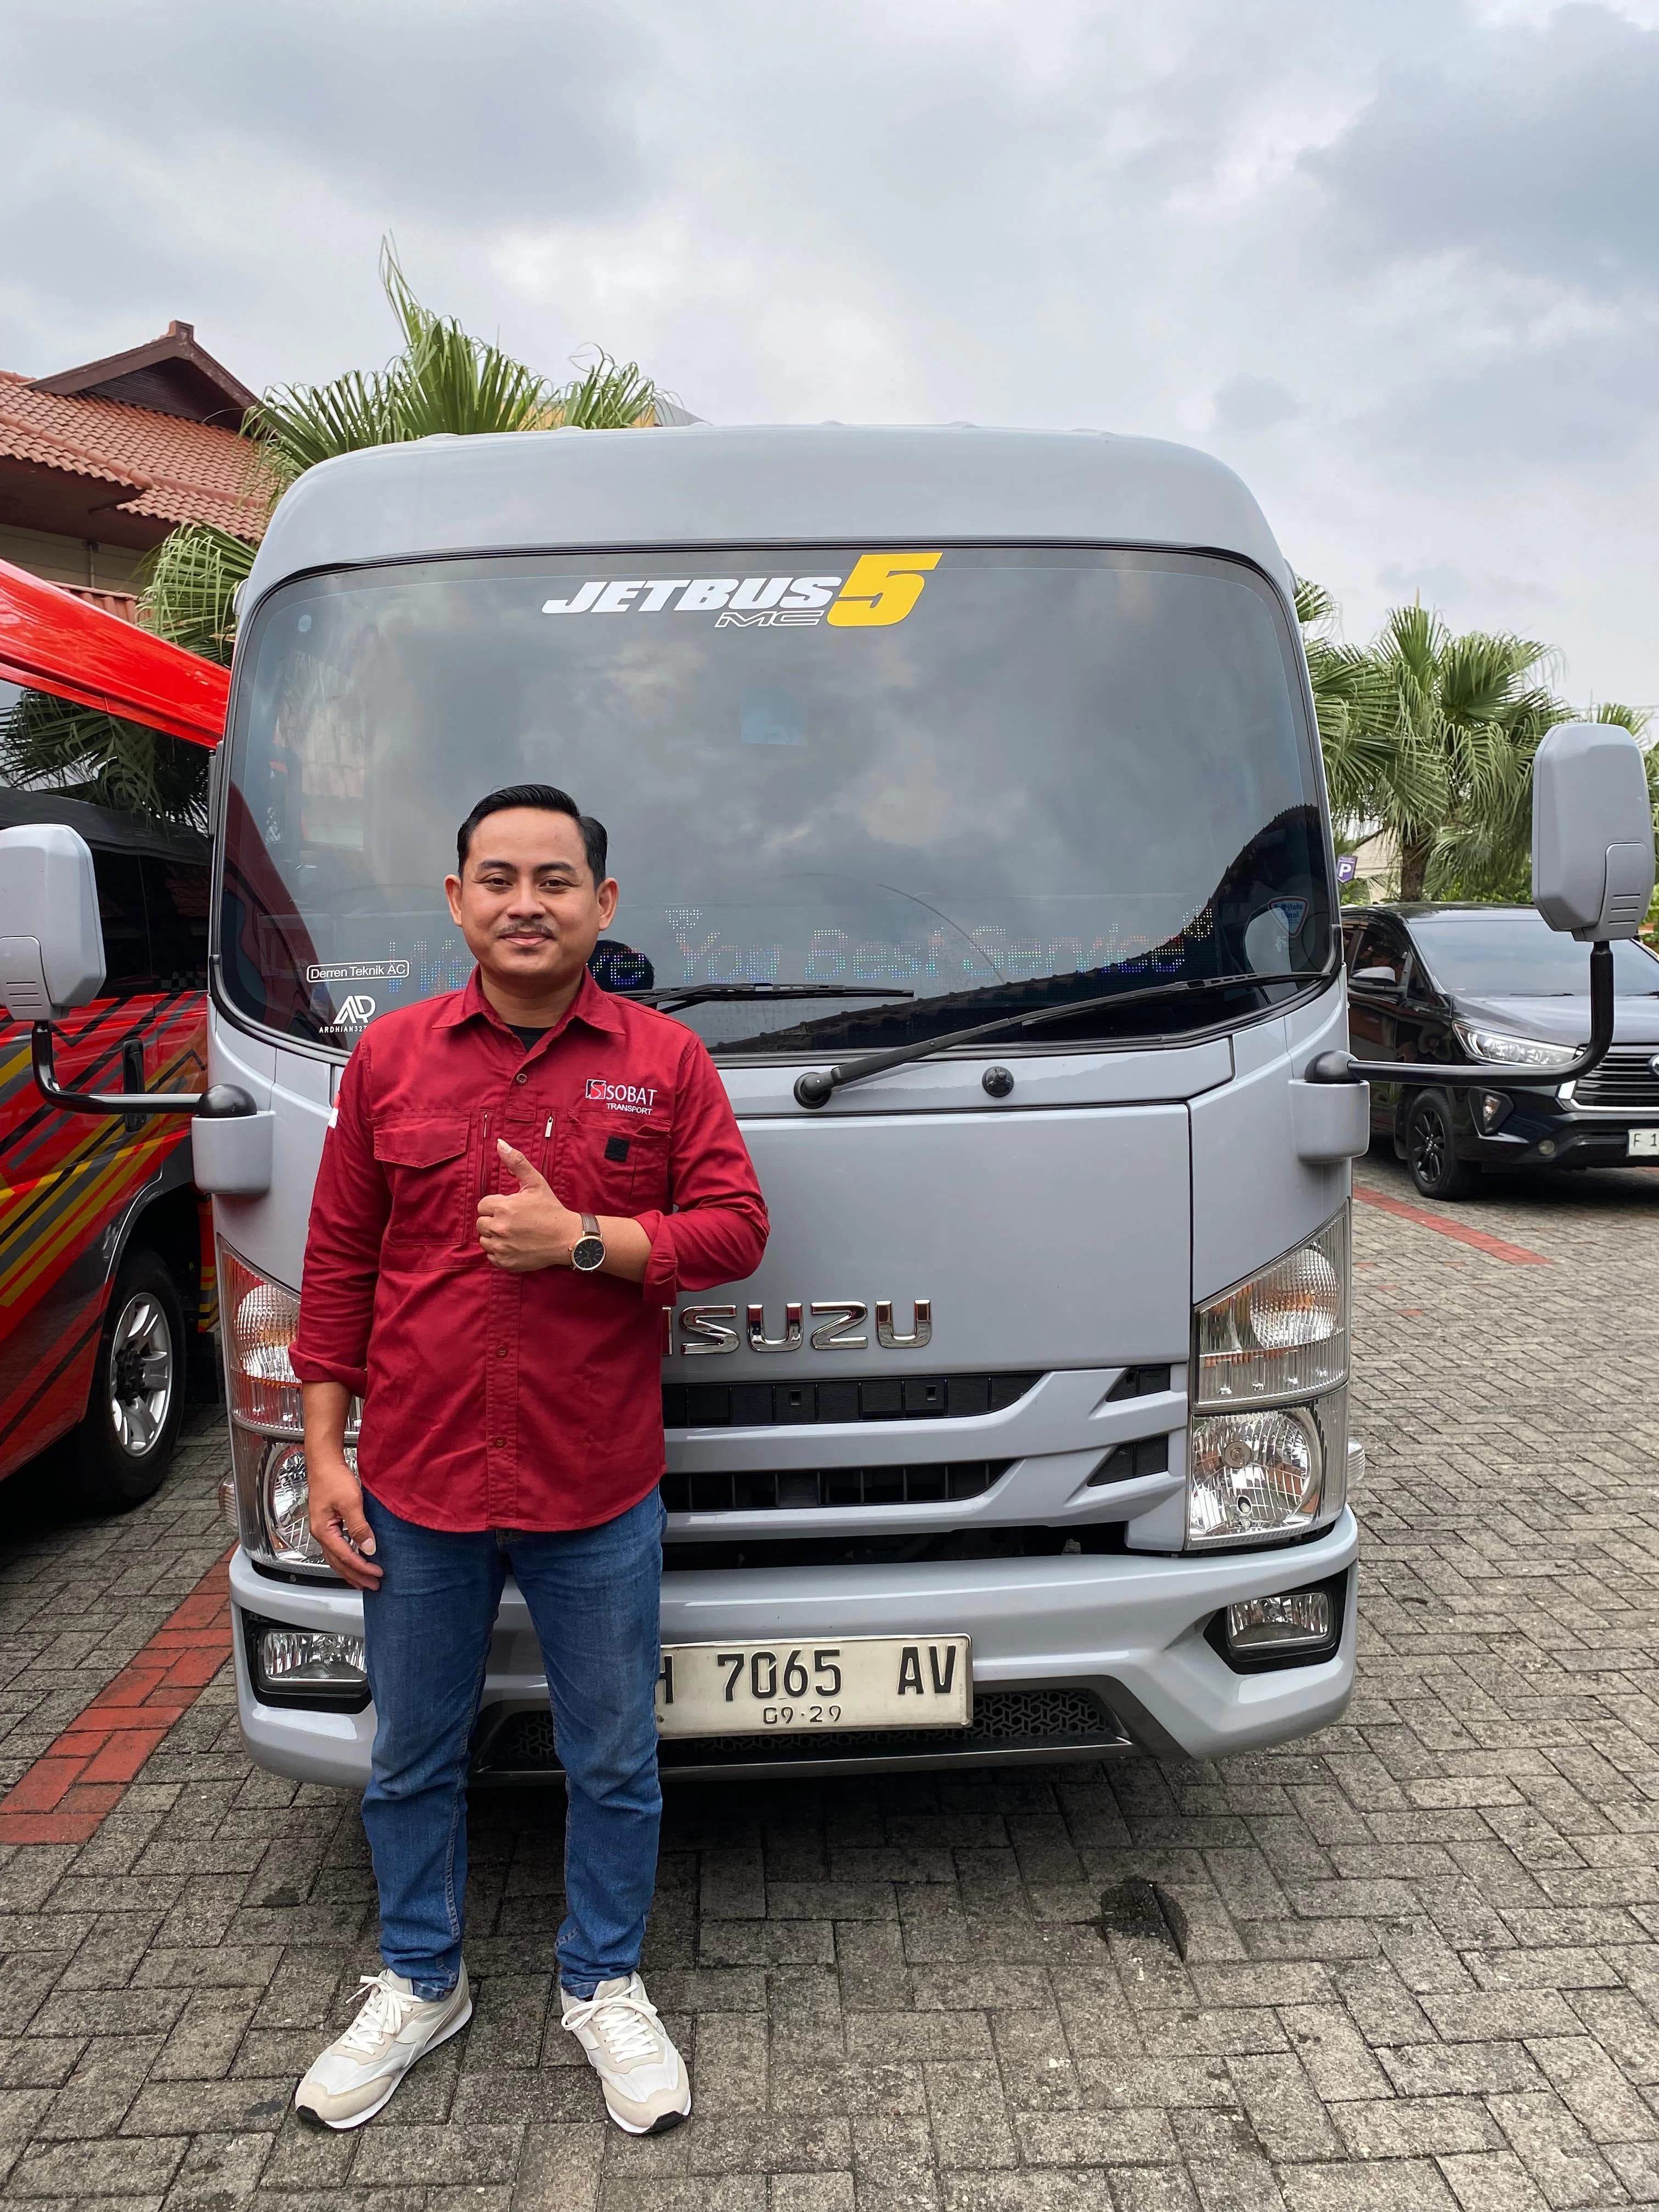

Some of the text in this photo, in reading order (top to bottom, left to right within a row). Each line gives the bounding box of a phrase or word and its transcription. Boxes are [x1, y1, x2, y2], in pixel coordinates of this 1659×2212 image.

[714, 610, 825, 628] MC
[1339, 863, 1352, 877] P
[311, 964, 406, 979] Derren Teknik AC
[606, 1085, 658, 1106] SOBAT
[606, 1103, 653, 1115] TRANSPORT
[1634, 1133, 1659, 1147] F 1
[716, 1649, 842, 1701] 7065
[898, 1645, 956, 1695] AV
